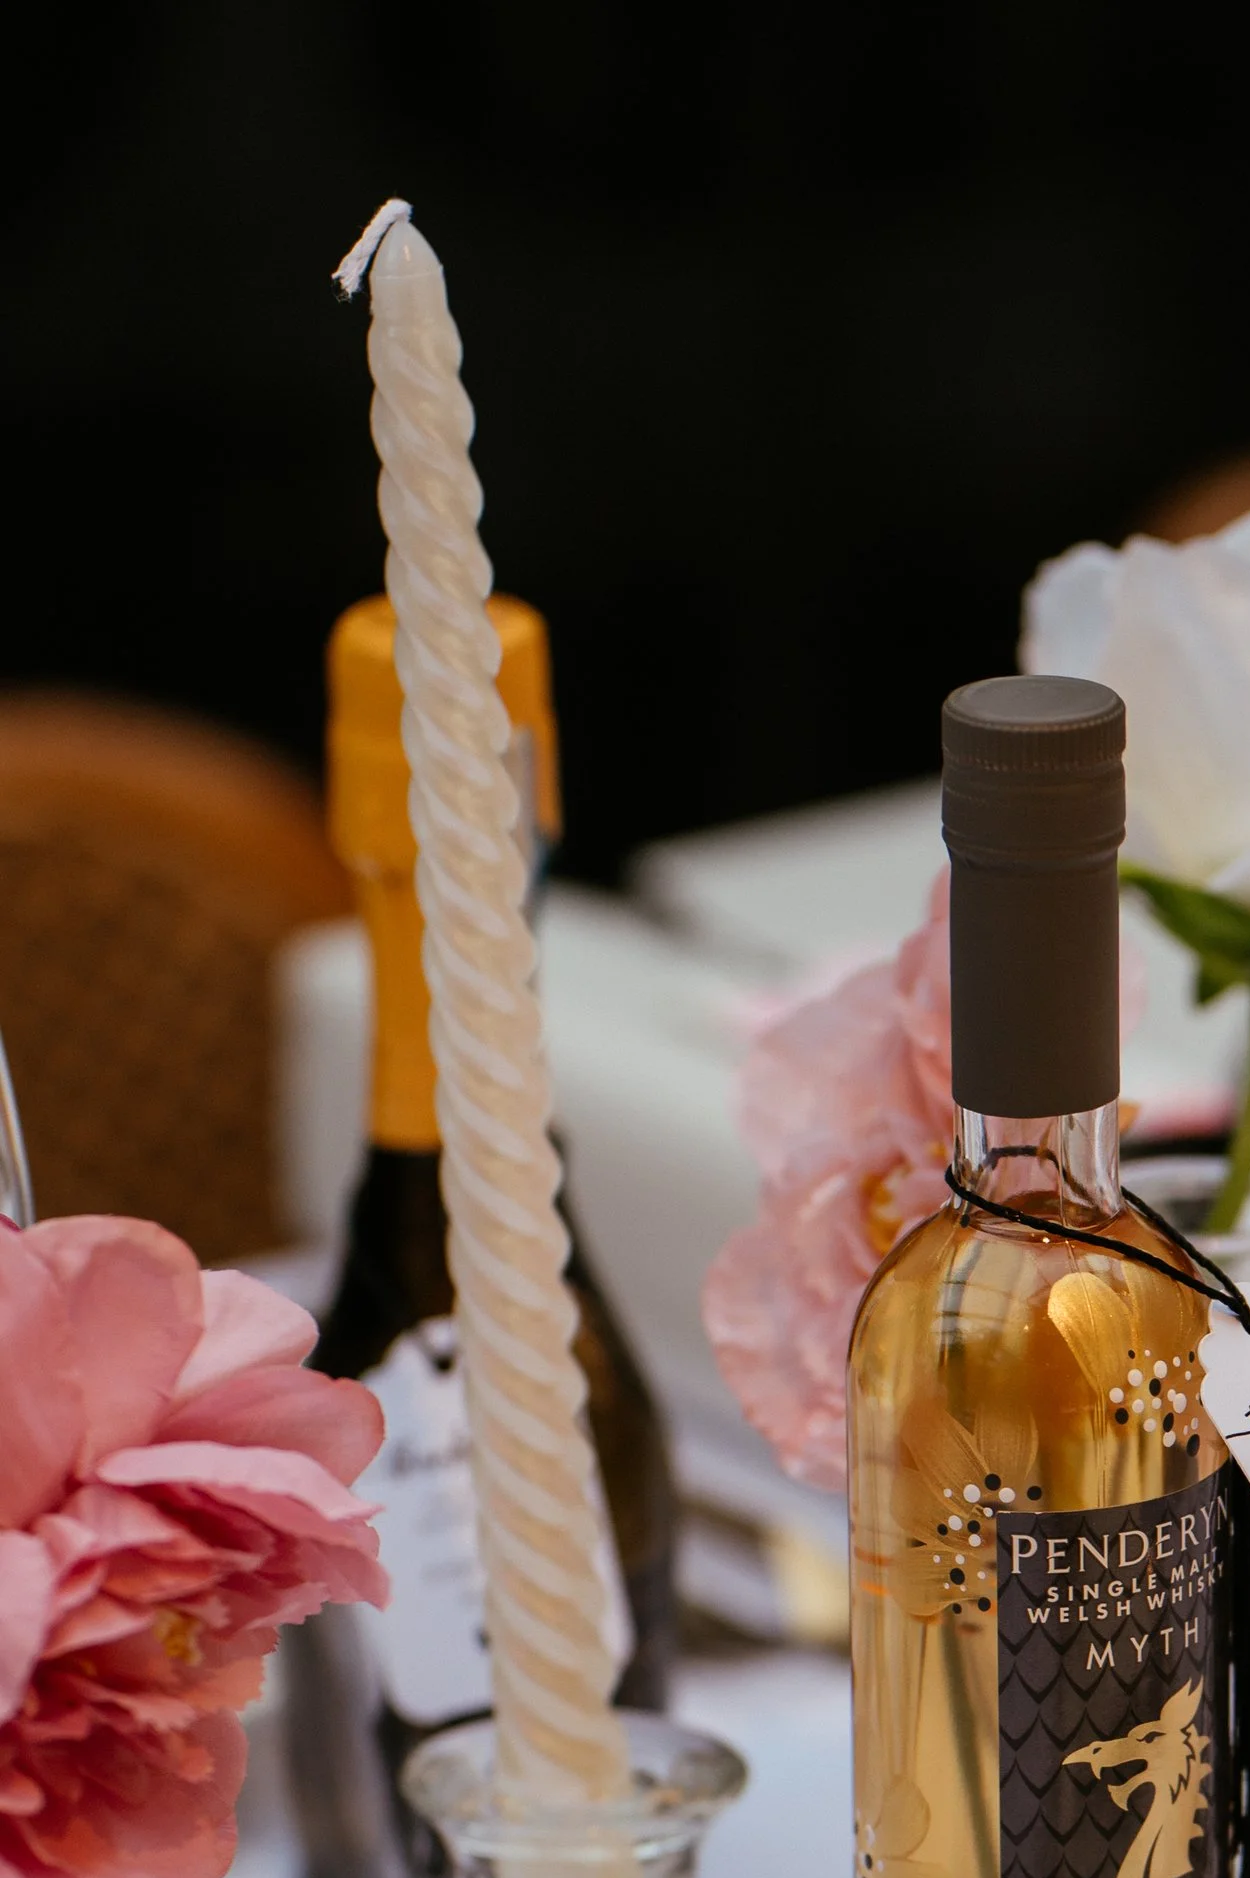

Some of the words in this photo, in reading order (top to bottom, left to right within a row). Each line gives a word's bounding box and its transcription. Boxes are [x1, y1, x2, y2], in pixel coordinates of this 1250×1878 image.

[1010, 1487, 1229, 1575] PENDERYN
[1027, 1600, 1131, 1624] WELSH
[1146, 1560, 1225, 1611] WHISKY
[1047, 1573, 1157, 1603] SINGLE
[1170, 1546, 1218, 1584] MALT
[1086, 1617, 1199, 1670] MYTH
